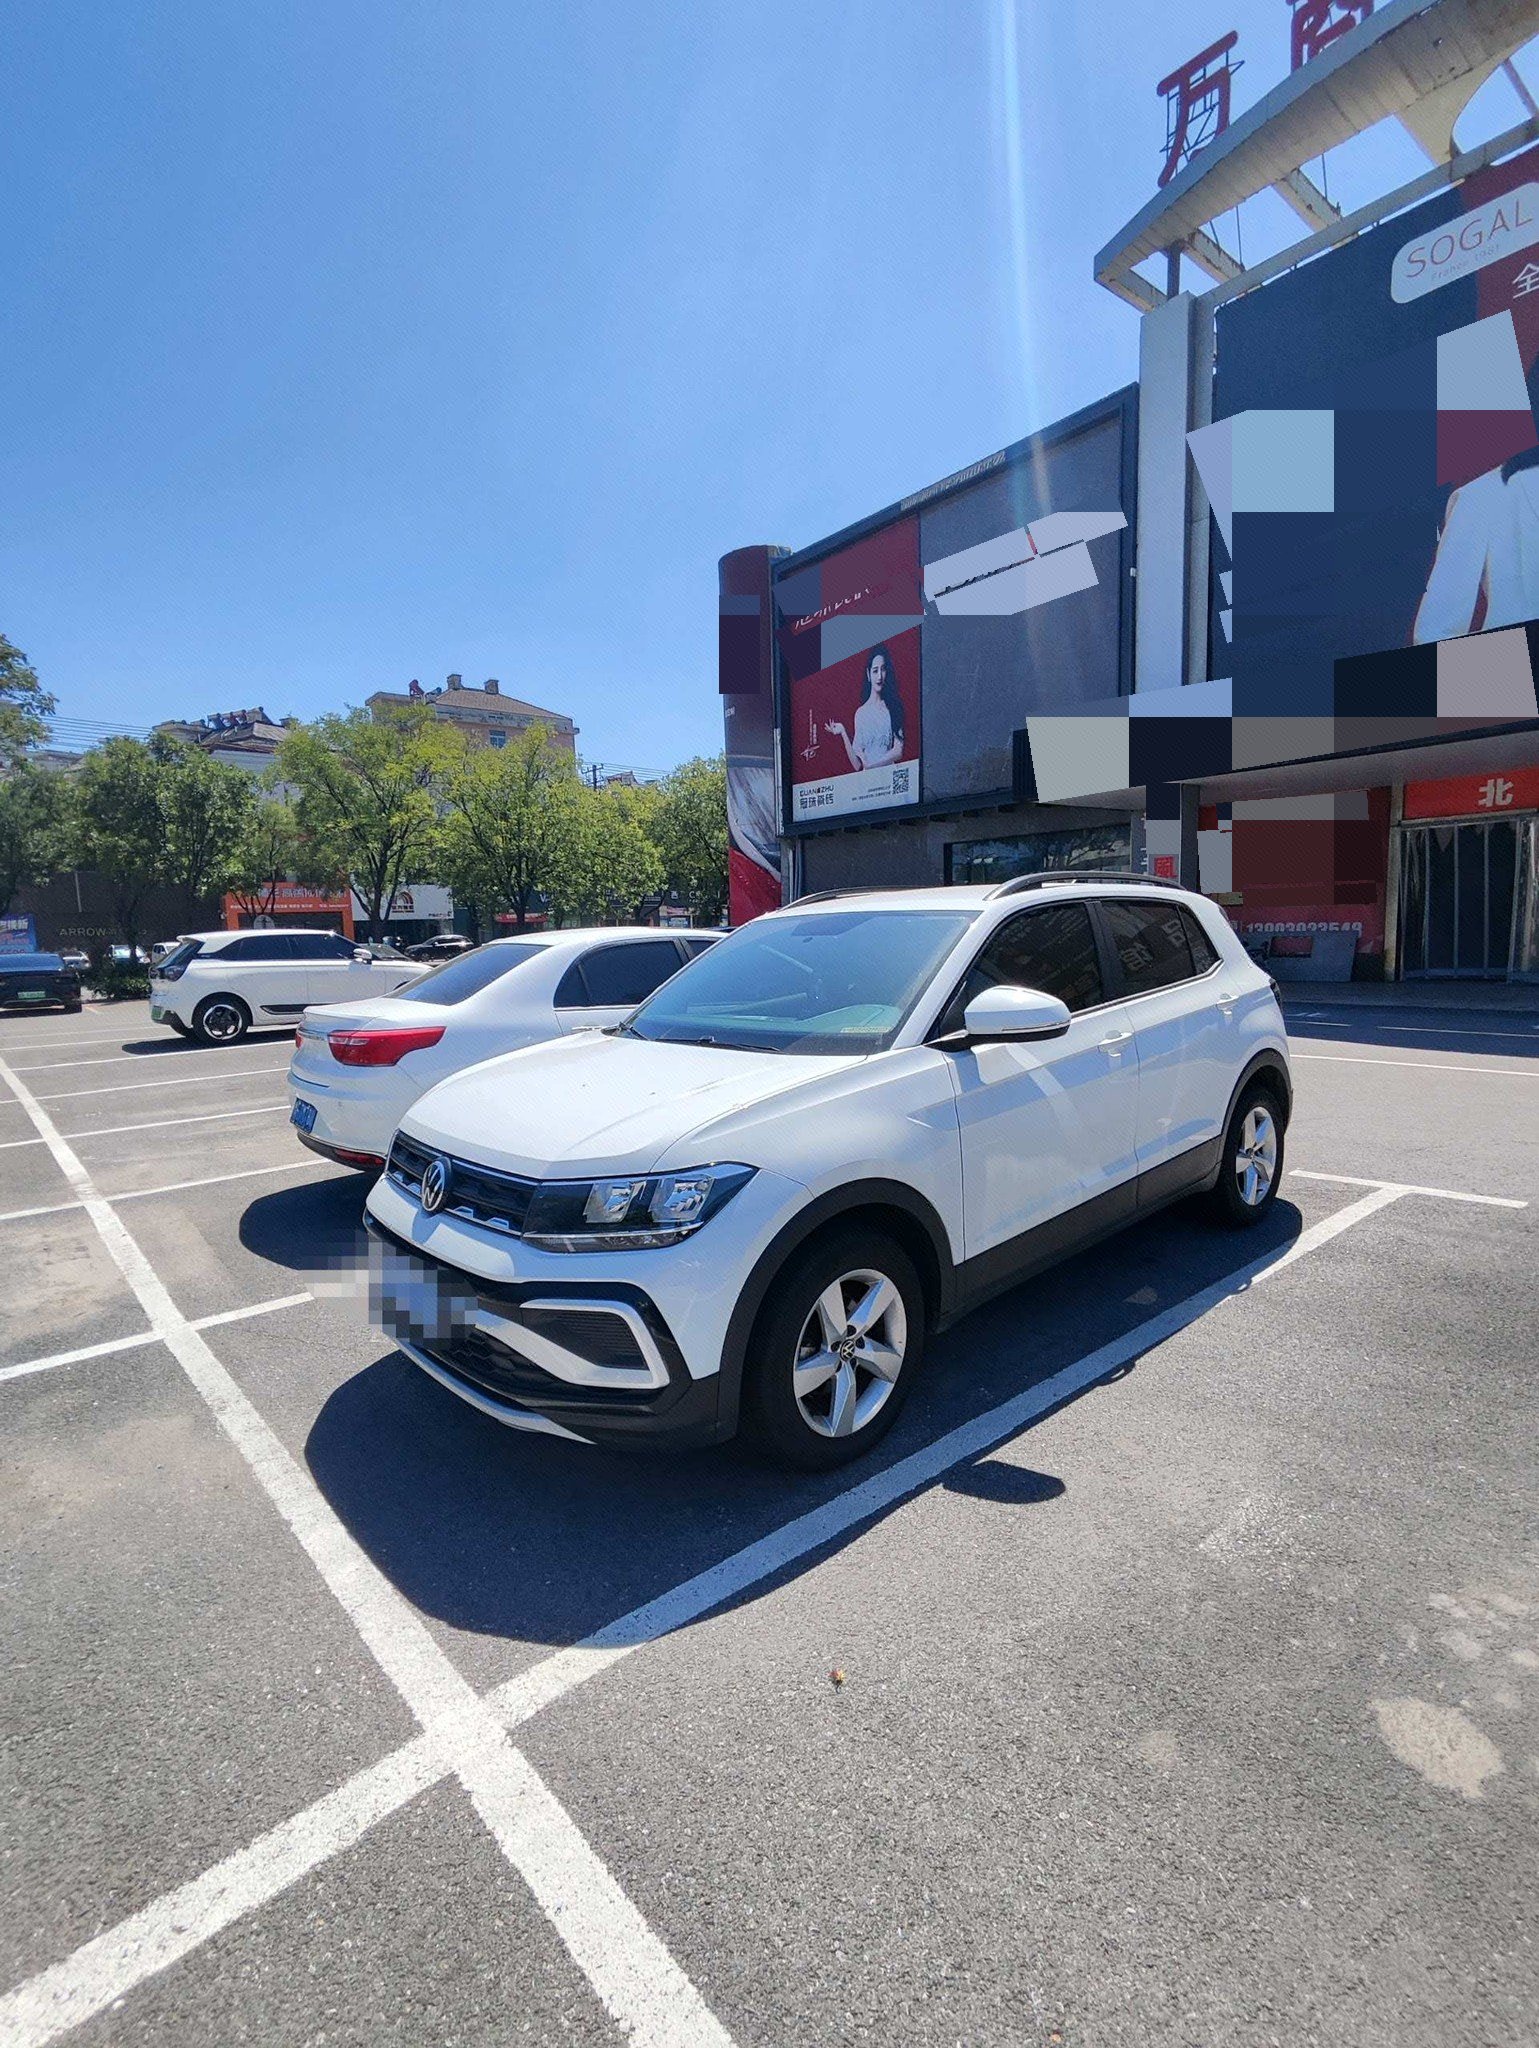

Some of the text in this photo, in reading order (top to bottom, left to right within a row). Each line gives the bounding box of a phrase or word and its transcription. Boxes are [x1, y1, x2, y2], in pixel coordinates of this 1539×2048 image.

[1406, 199, 1533, 278] SOGAL
[1512, 263, 1539, 299] 全
[1478, 778, 1514, 807] 北
[59, 927, 107, 937] ARROW
